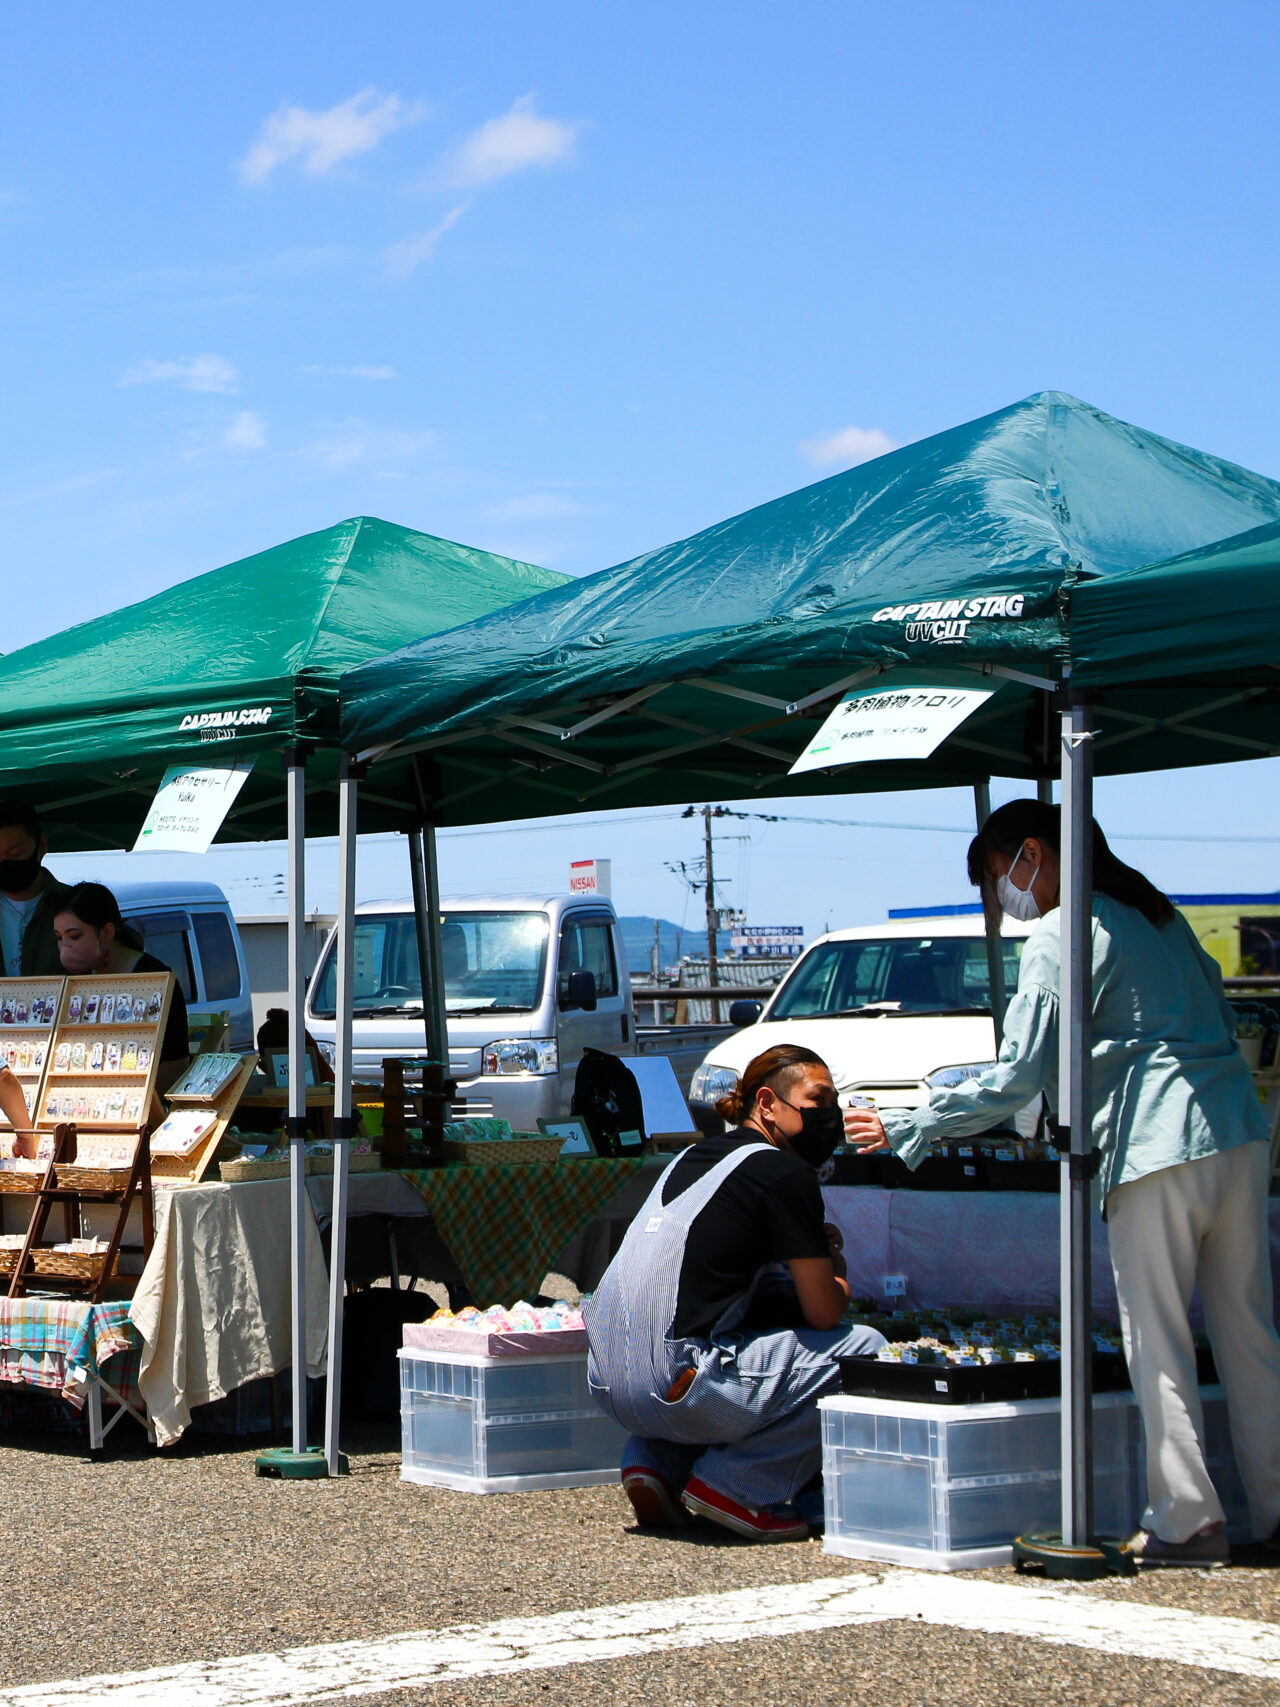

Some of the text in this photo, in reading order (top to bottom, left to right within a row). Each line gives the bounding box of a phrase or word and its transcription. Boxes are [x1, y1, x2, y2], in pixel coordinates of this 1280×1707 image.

[872, 594, 1025, 622] CAPTAIN STAG
[843, 694, 966, 716] 多肉植物クロリ
[178, 706, 273, 731] CAPTAIN STAG
[570, 876, 596, 891] NISSAN
